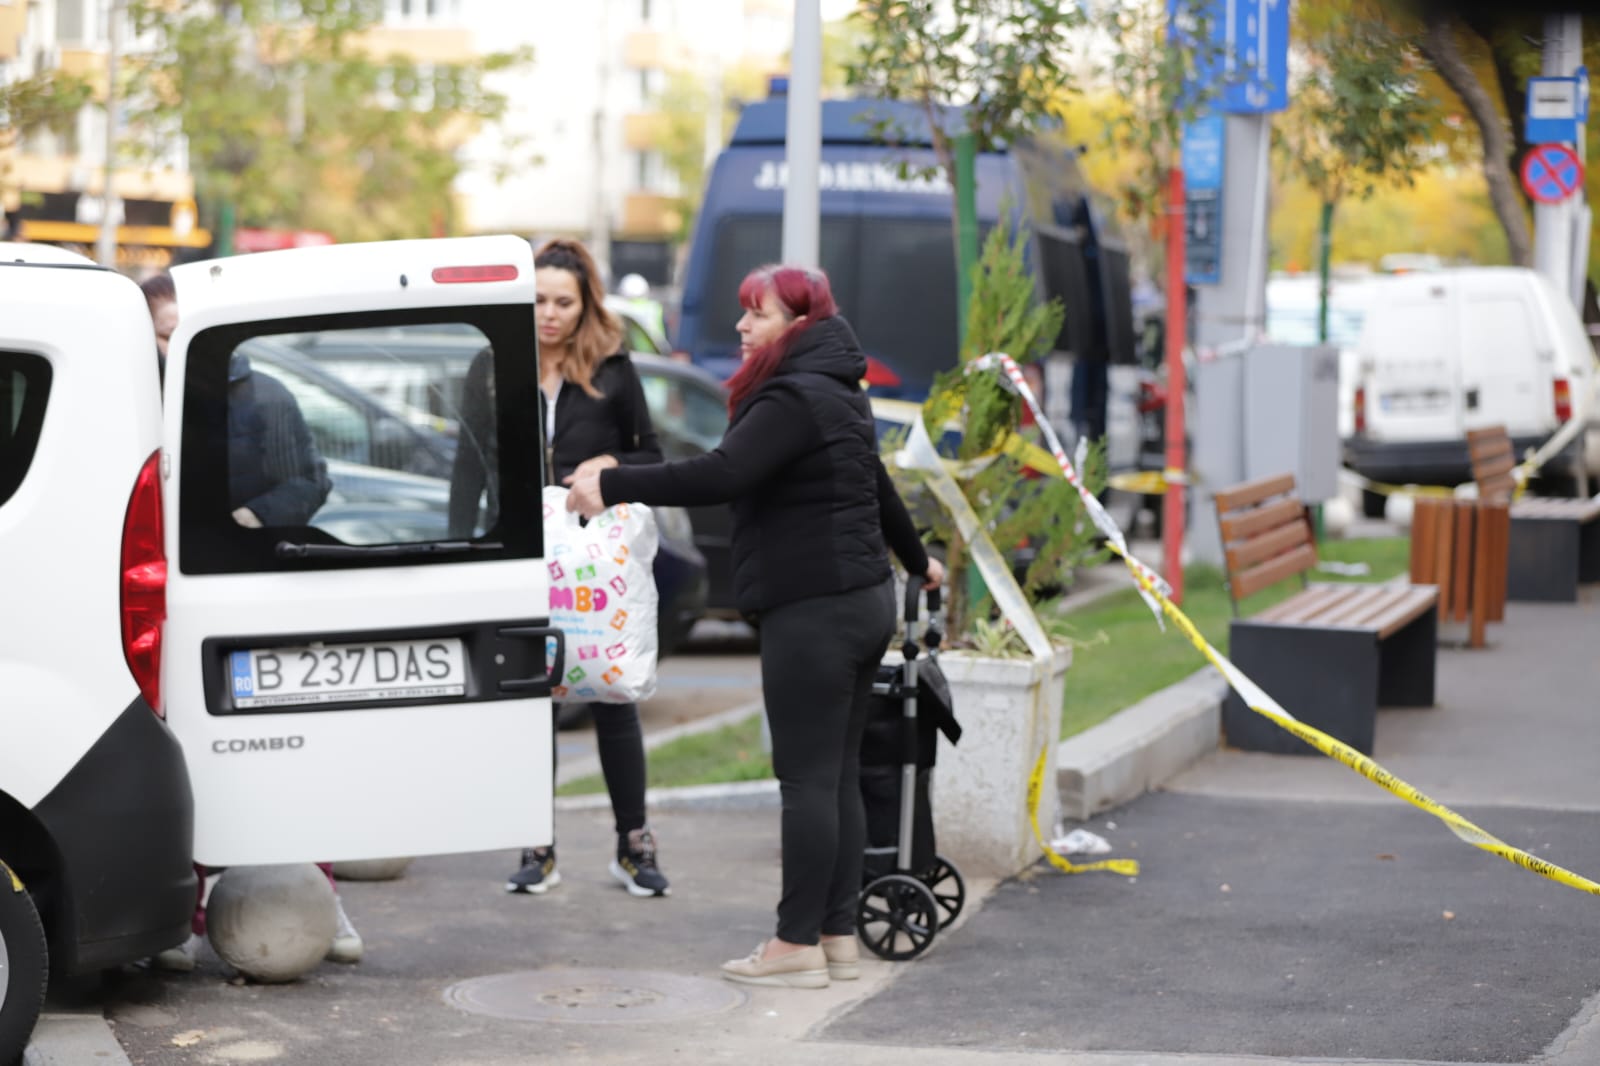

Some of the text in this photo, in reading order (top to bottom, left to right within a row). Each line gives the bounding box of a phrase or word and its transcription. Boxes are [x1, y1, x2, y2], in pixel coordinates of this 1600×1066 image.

[256, 653, 283, 691] B
[235, 677, 252, 692] RO
[212, 736, 305, 754] COMBO
